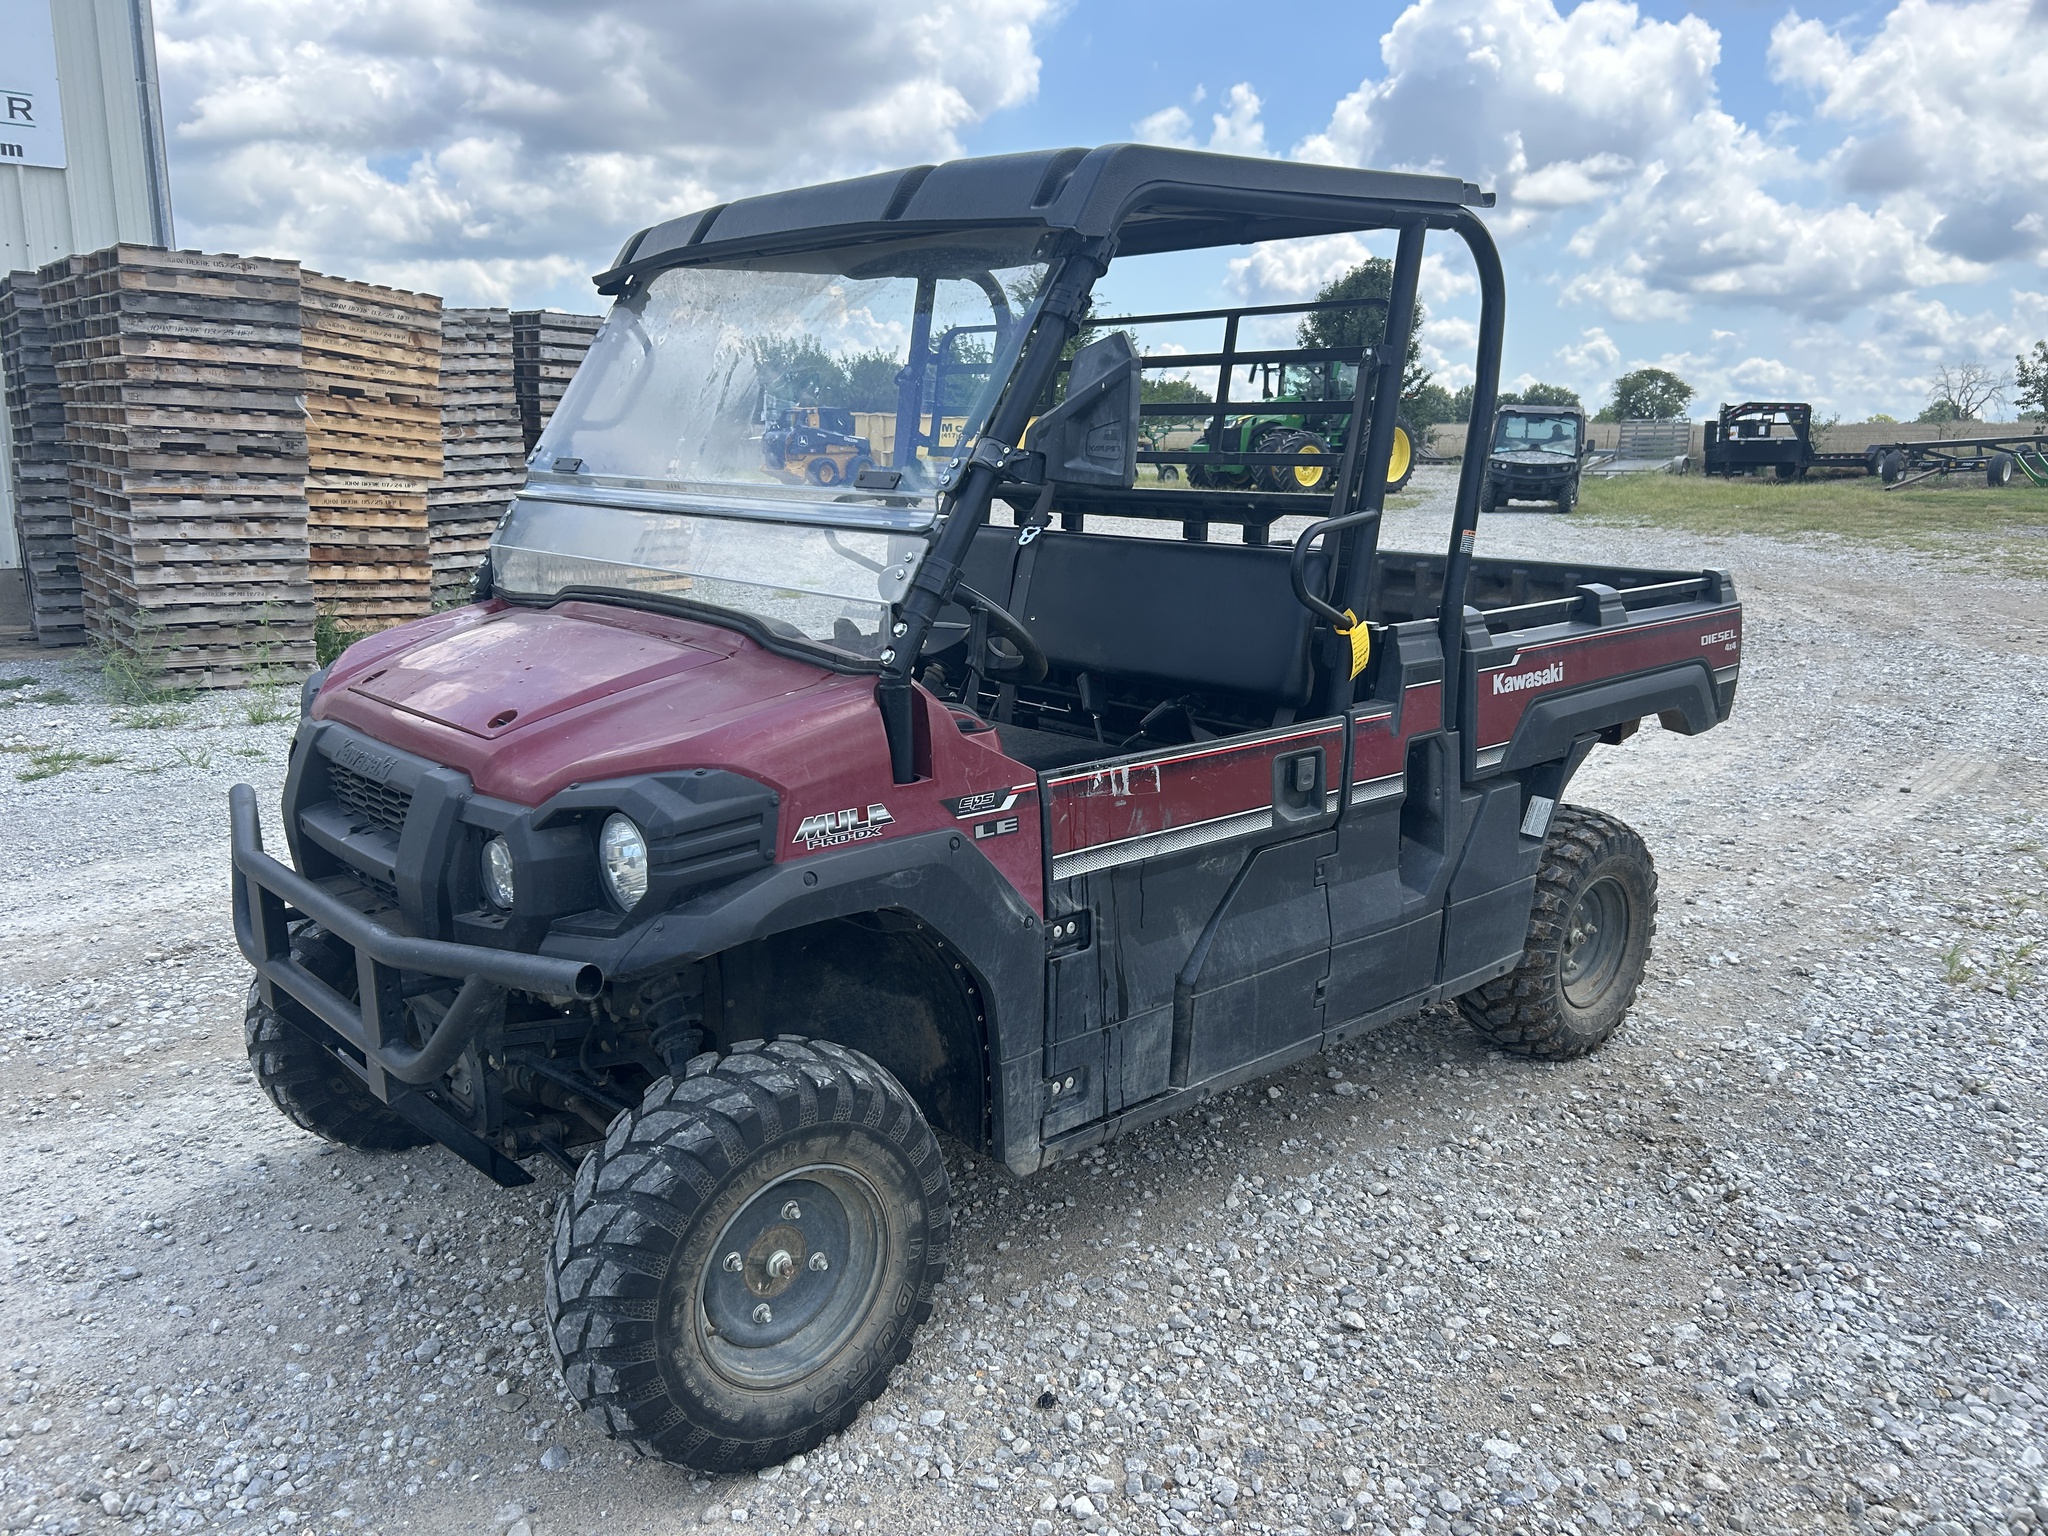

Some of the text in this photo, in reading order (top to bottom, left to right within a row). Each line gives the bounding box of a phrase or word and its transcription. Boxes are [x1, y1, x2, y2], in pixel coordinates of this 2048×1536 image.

[185, 258, 210, 266] DEERE
[213, 260, 241, 270] 05/25
[329, 302, 347, 310] JOHN
[348, 305, 370, 314] DEERE
[371, 309, 395, 318] 03/25
[1700, 629, 1737, 646] DIESEL
[1724, 642, 1737, 652] 4x4
[1493, 661, 1564, 695] Kawasaki
[335, 738, 399, 780] Kawasaki
[792, 803, 896, 844] MULE
[975, 818, 1018, 839] LE
[807, 826, 883, 850] PRO-DX
[678, 1140, 799, 1269] FRONTIER
[812, 1281, 915, 1414] DURO
